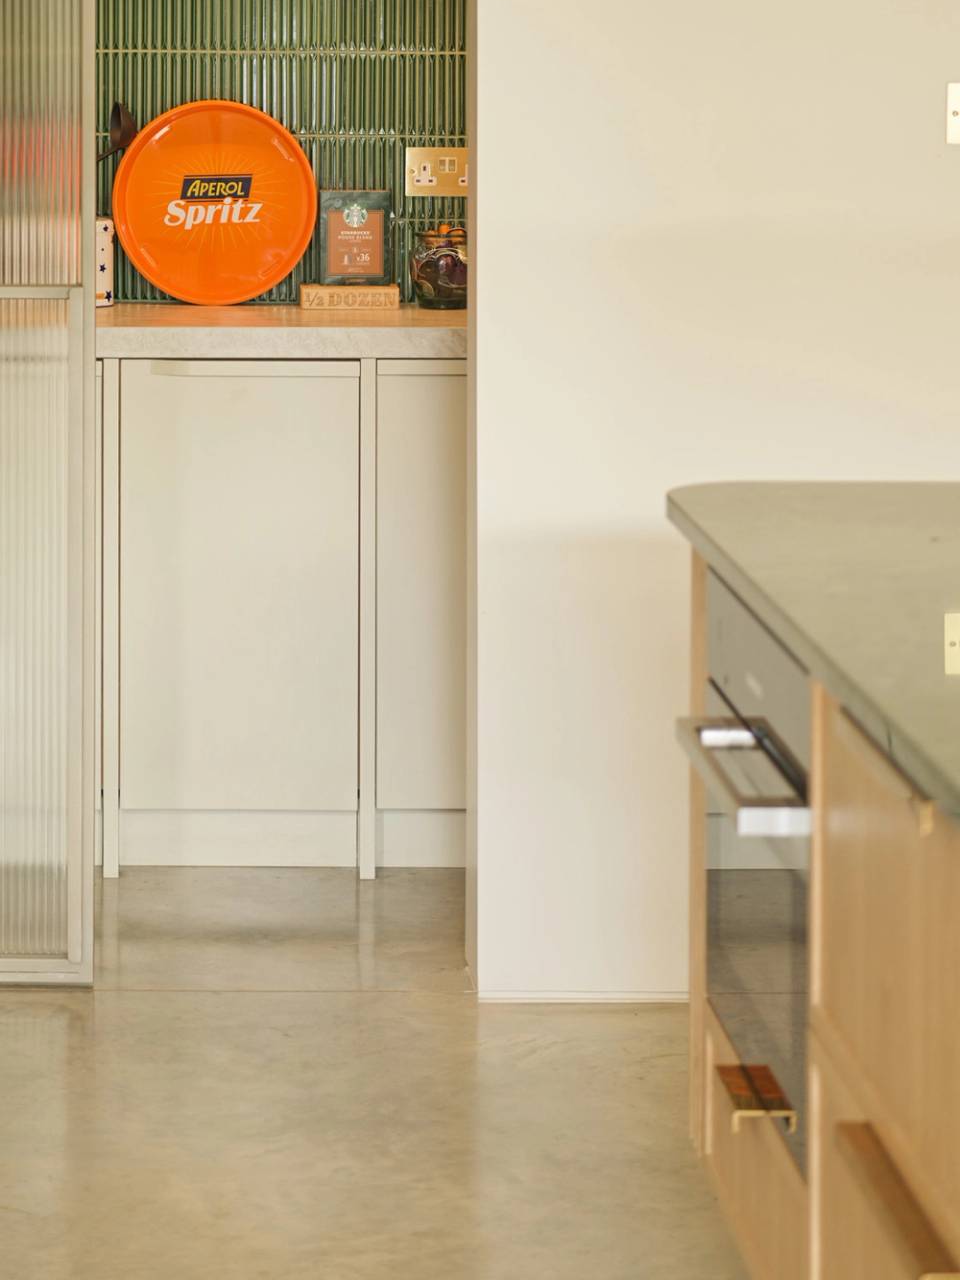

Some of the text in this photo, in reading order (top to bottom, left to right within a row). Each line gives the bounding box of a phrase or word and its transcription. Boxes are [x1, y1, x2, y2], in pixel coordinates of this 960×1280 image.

[186, 179, 245, 197] APEROL
[163, 196, 264, 231] Spritz
[327, 291, 396, 307] DOZEN
